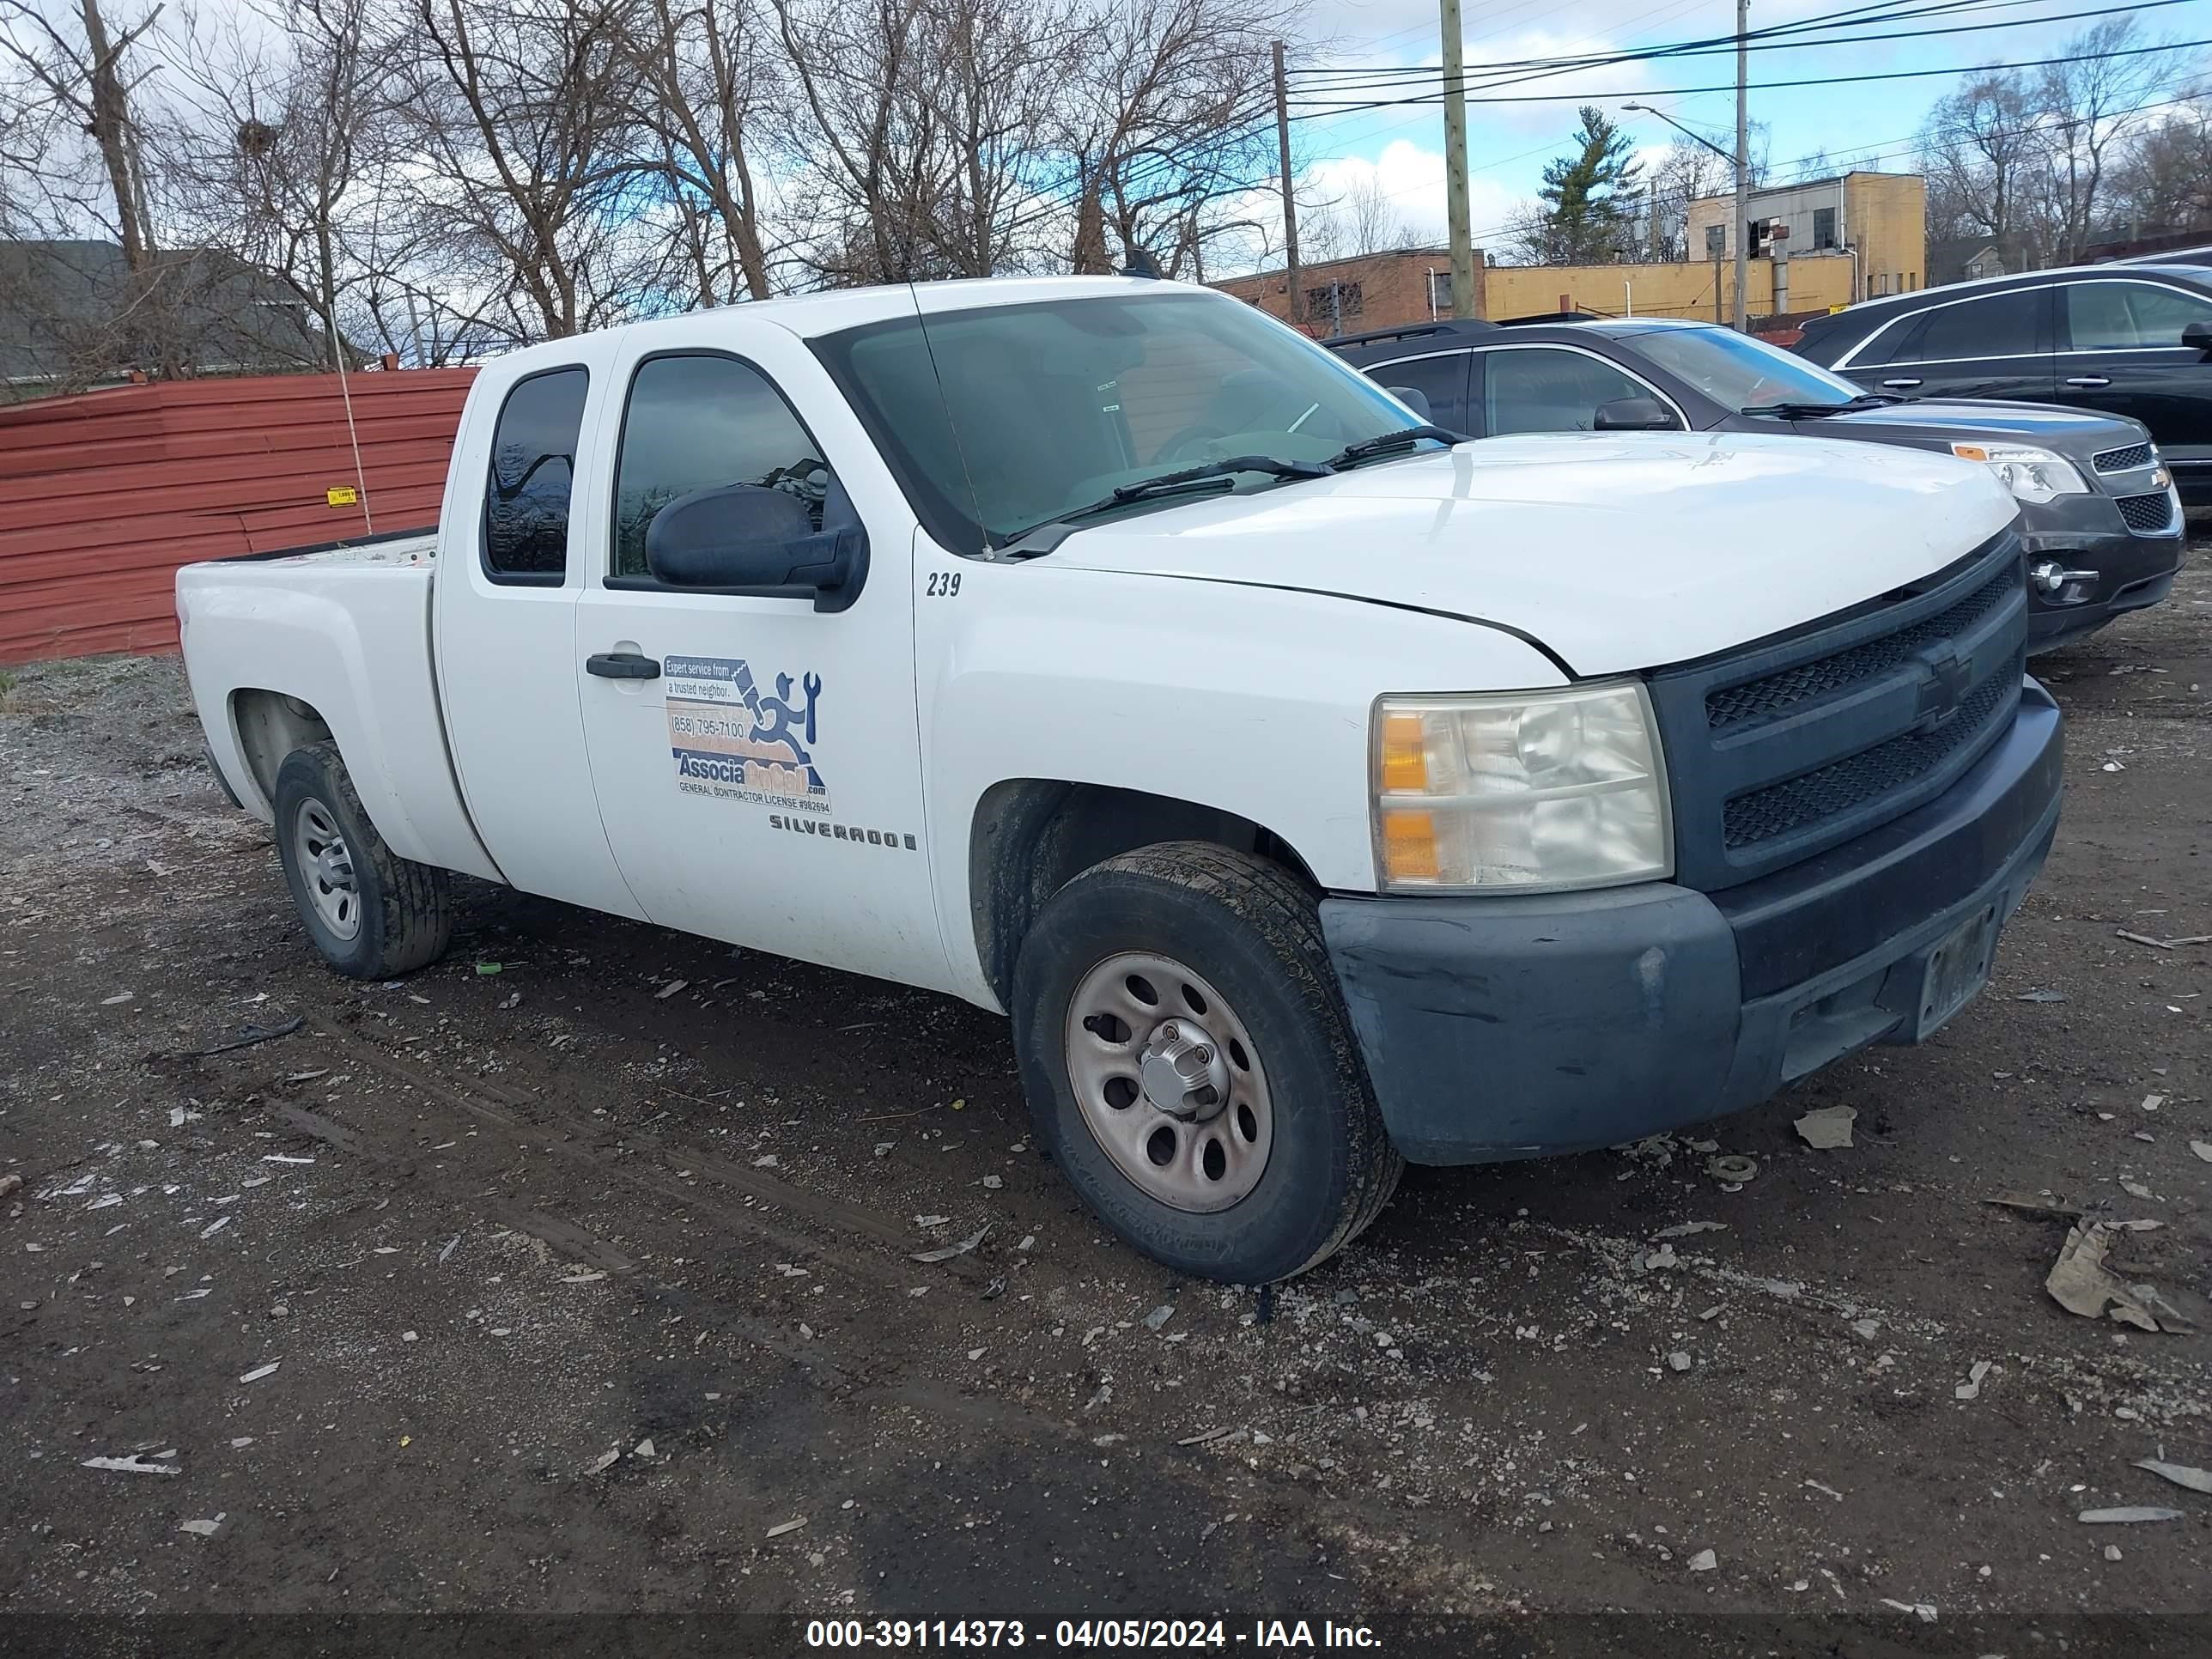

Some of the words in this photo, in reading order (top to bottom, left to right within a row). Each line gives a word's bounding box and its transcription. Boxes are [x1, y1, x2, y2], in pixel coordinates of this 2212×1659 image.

[926, 572, 962, 597] 239
[666, 659, 687, 677] Expert
[688, 662, 712, 676] service
[713, 662, 730, 677] from
[668, 682, 673, 691] a
[674, 681, 696, 695] trusted
[698, 683, 730, 699] neighbor.
[672, 715, 695, 736] (858)
[696, 718, 744, 738] 795-7100
[679, 782, 712, 795] GENERAL
[714, 787, 763, 804] CONTRACTOR
[764, 793, 798, 809] LICENSE
[799, 799, 830, 814] #982694
[769, 814, 898, 848] SILVERADO
